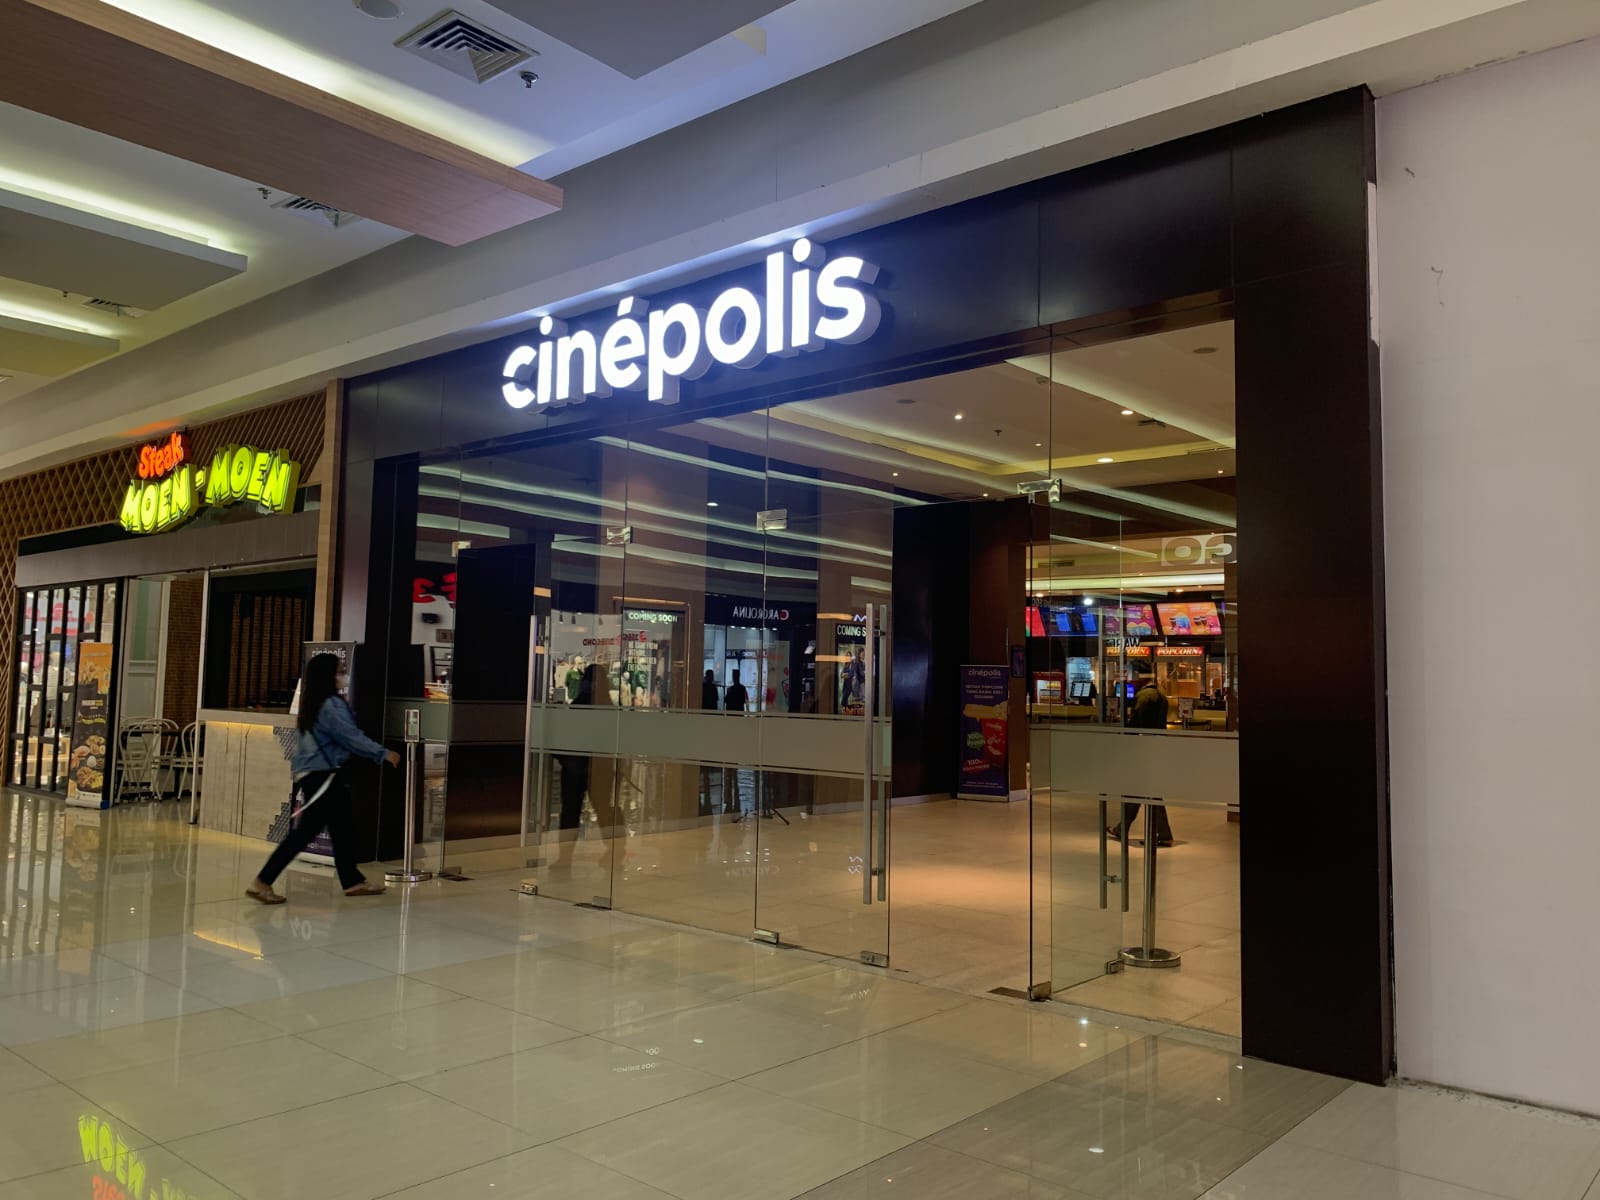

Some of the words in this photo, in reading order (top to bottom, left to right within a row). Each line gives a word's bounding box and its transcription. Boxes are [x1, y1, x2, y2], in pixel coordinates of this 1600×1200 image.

[502, 238, 866, 409] cinépolis
[138, 431, 184, 479] Steak
[628, 612, 657, 623] COMING
[658, 614, 678, 624] SOON
[836, 624, 862, 637] COMING
[1156, 646, 1200, 656] POPCORN
